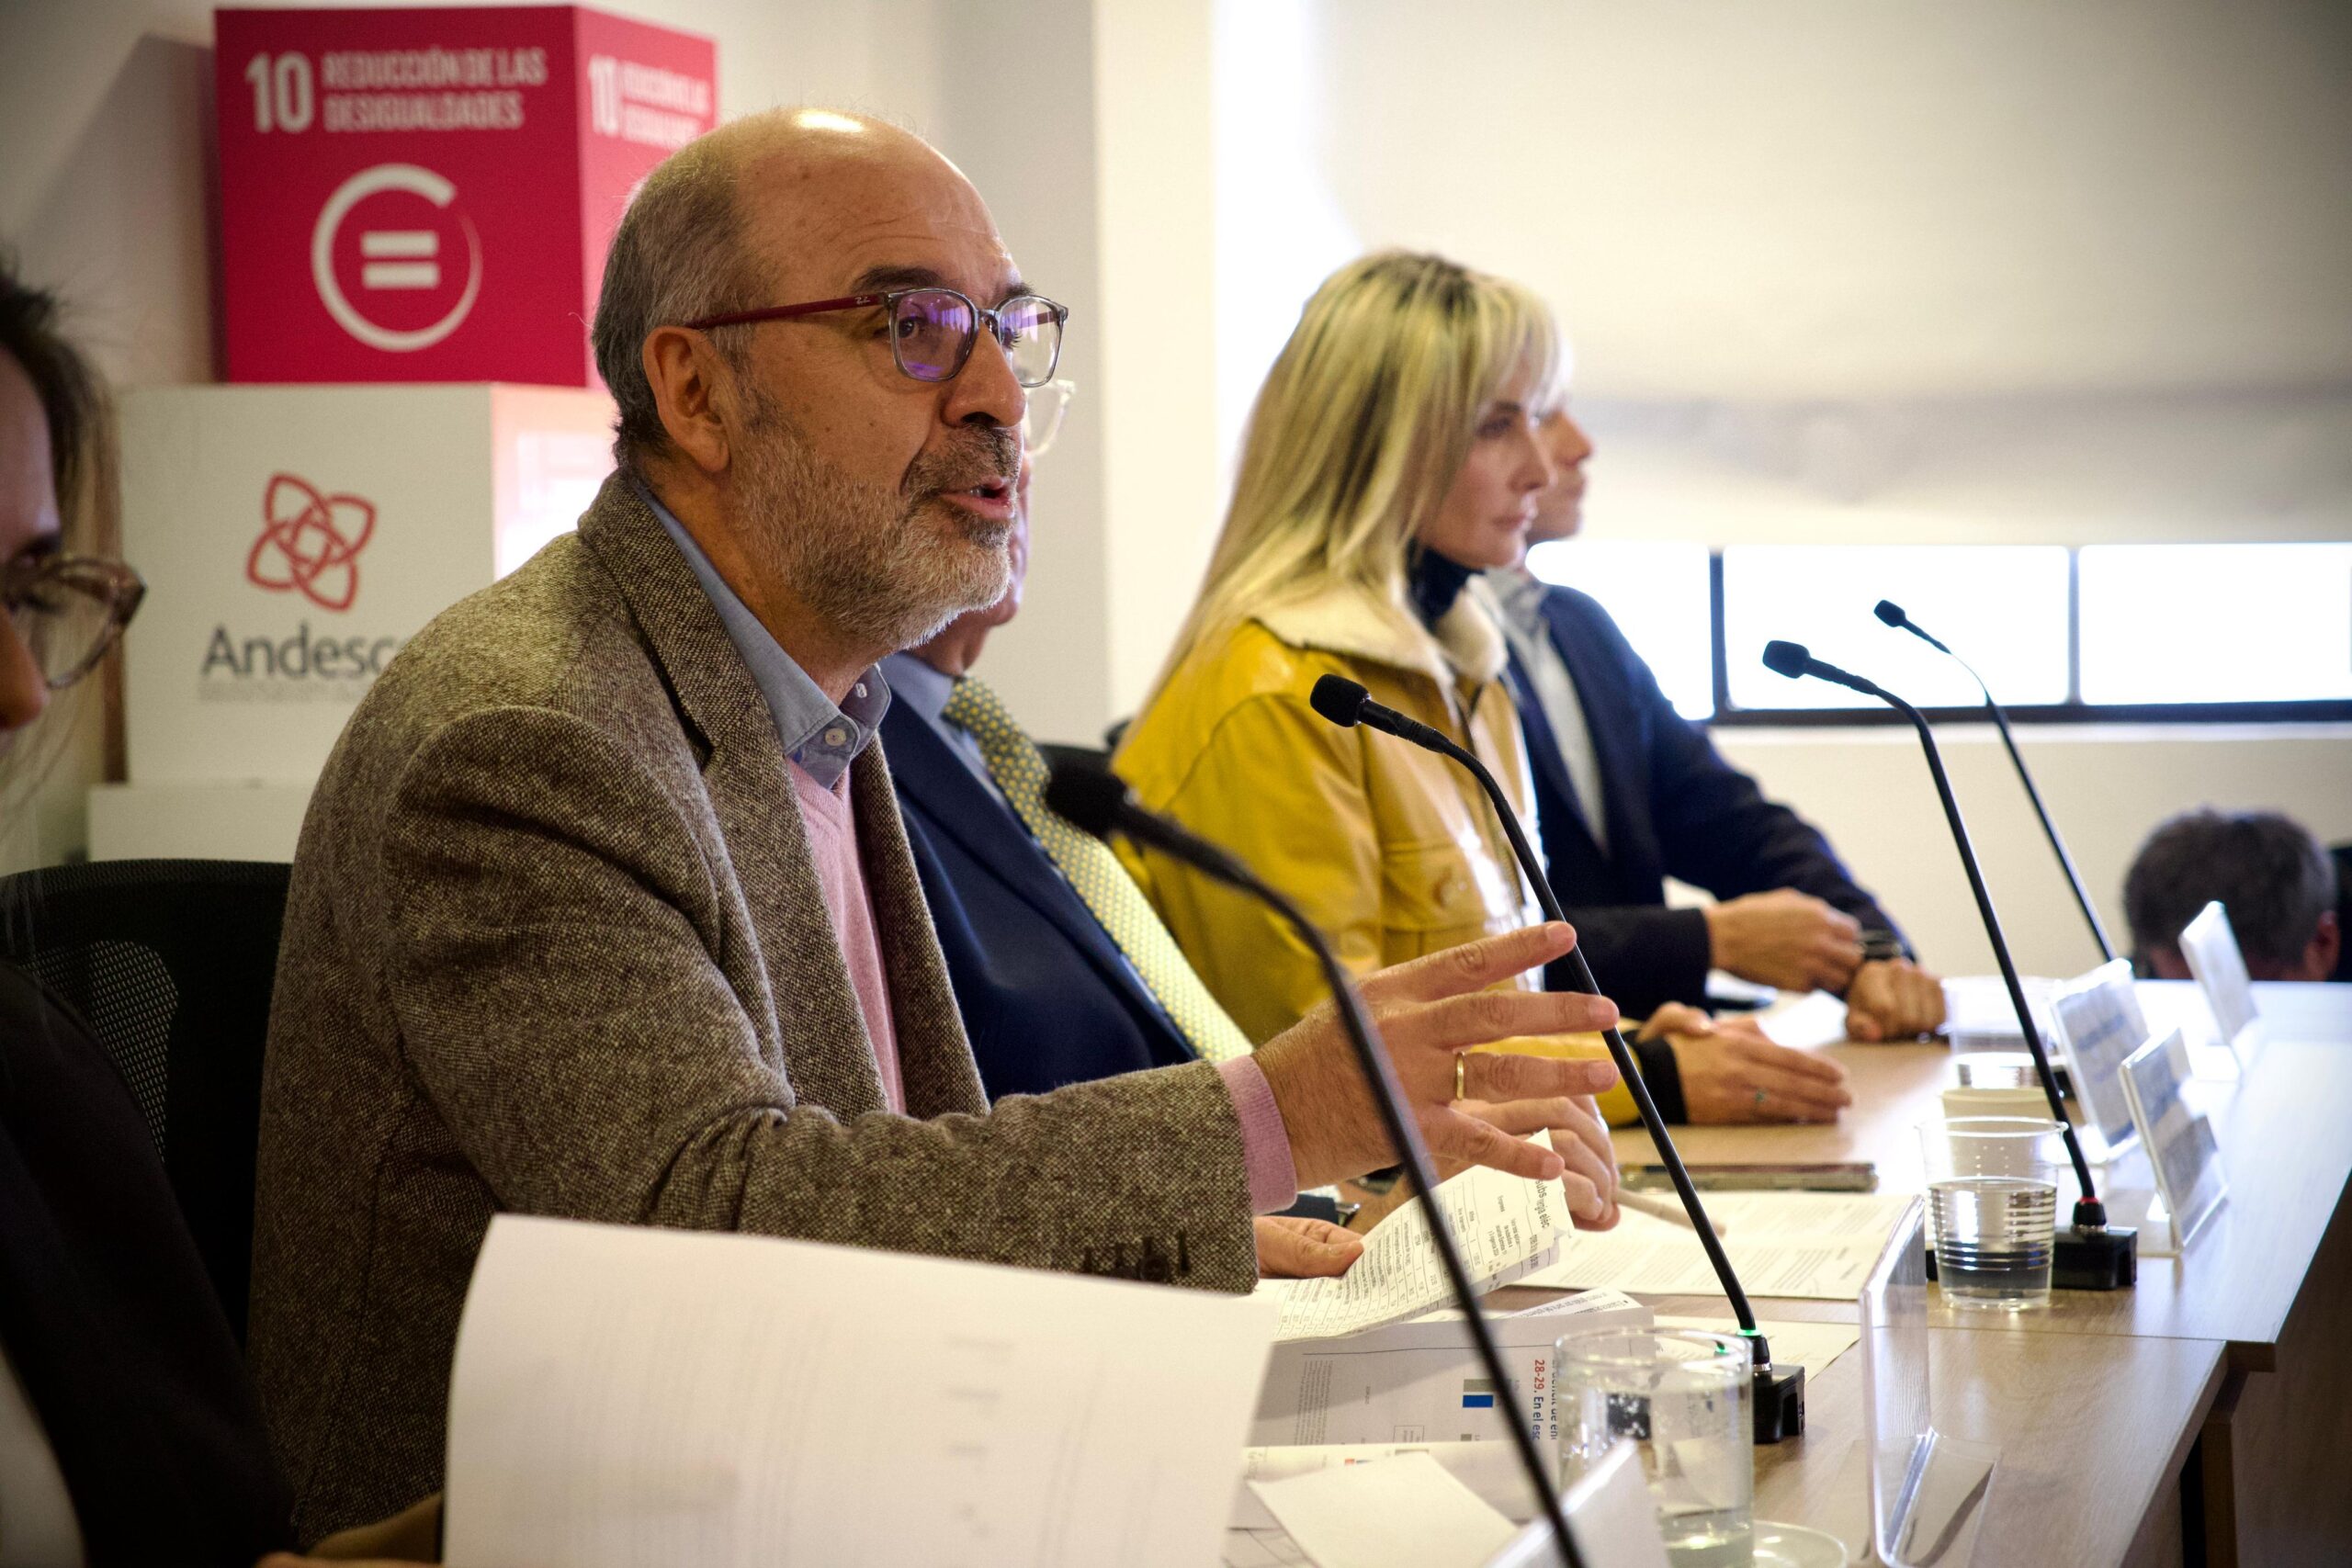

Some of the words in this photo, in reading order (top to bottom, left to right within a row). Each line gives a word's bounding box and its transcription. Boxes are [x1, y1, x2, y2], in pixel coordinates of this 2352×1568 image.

[244, 51, 313, 133] 10
[201, 620, 396, 680] Andesc
[1533, 1359, 1544, 1393] 28-29.
[1532, 1411, 1544, 1422] el
[1533, 1396, 1544, 1409] En
